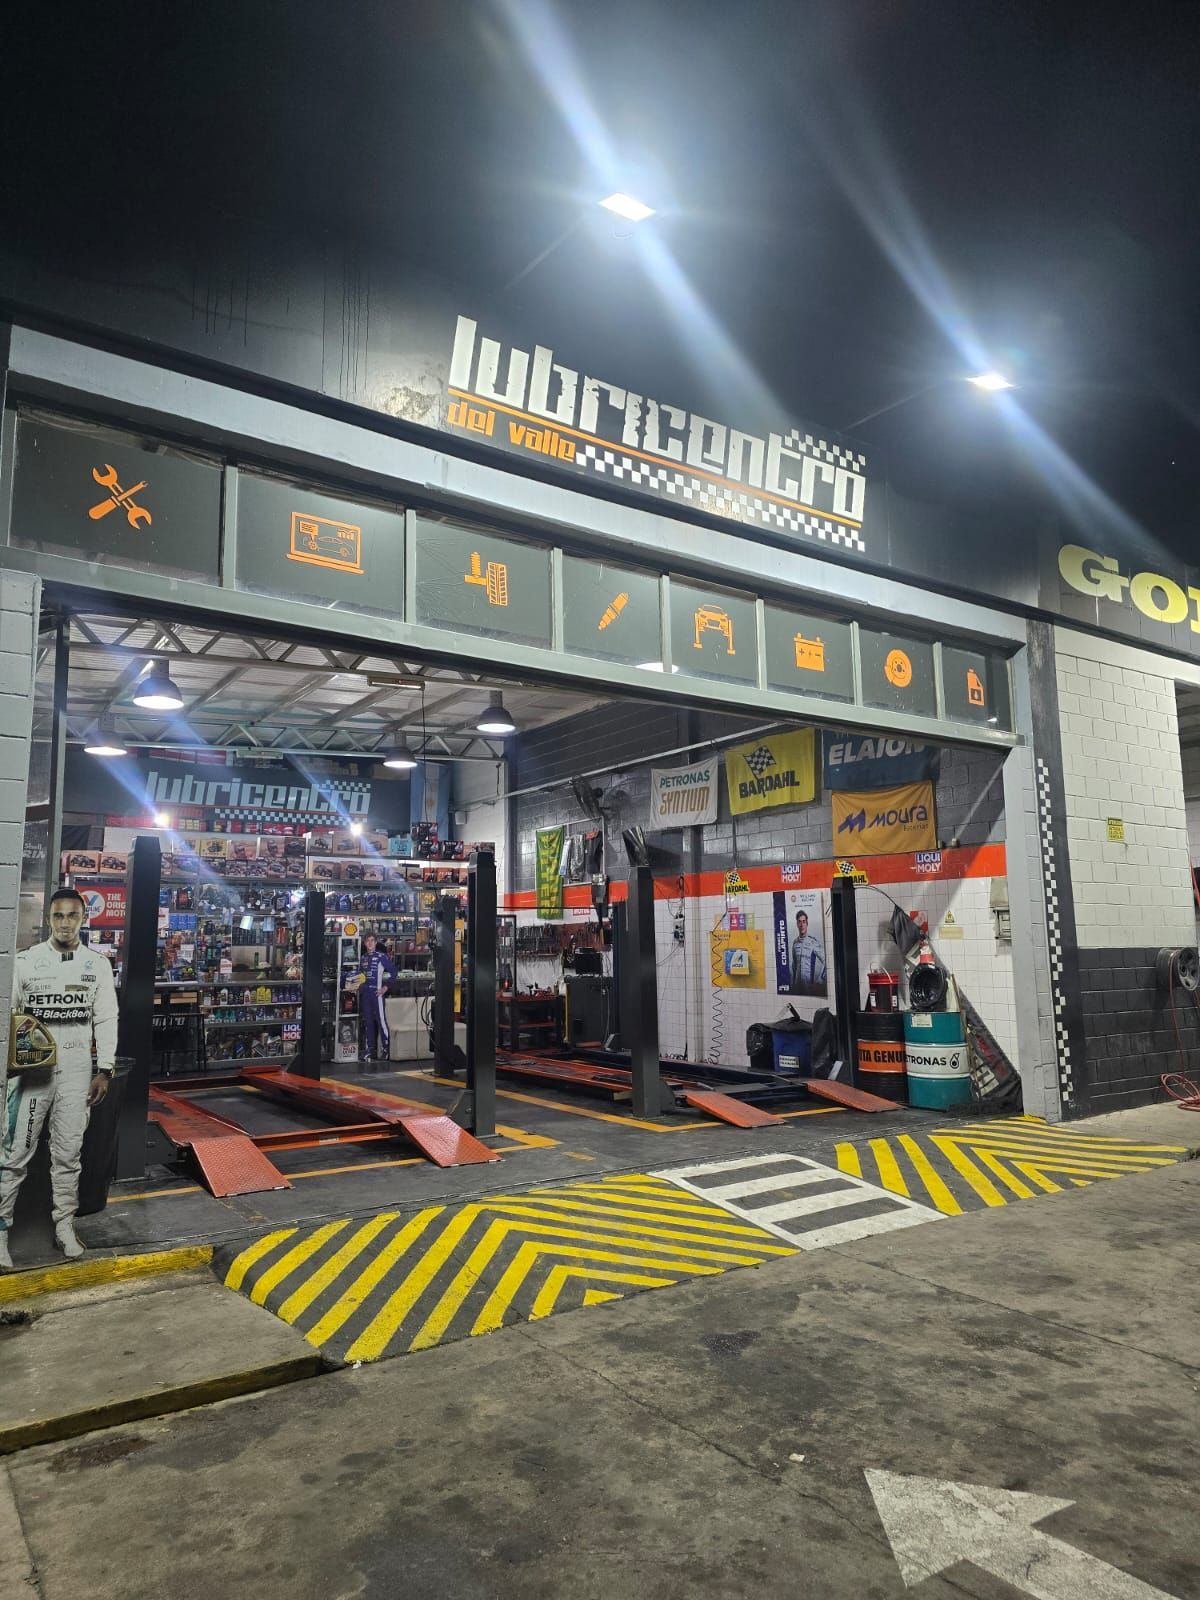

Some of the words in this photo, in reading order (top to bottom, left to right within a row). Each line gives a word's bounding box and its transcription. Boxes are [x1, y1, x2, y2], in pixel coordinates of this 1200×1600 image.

[447, 401, 496, 437] del
[508, 421, 577, 464] valle
[659, 769, 711, 789] PETRONAS
[738, 769, 800, 799] BARDAHL
[145, 771, 371, 815] lubricentro
[916, 853, 942, 865] LIQUI
[781, 864, 800, 875] LIQUI
[916, 862, 942, 873] MOLY
[781, 873, 800, 883] MOLY
